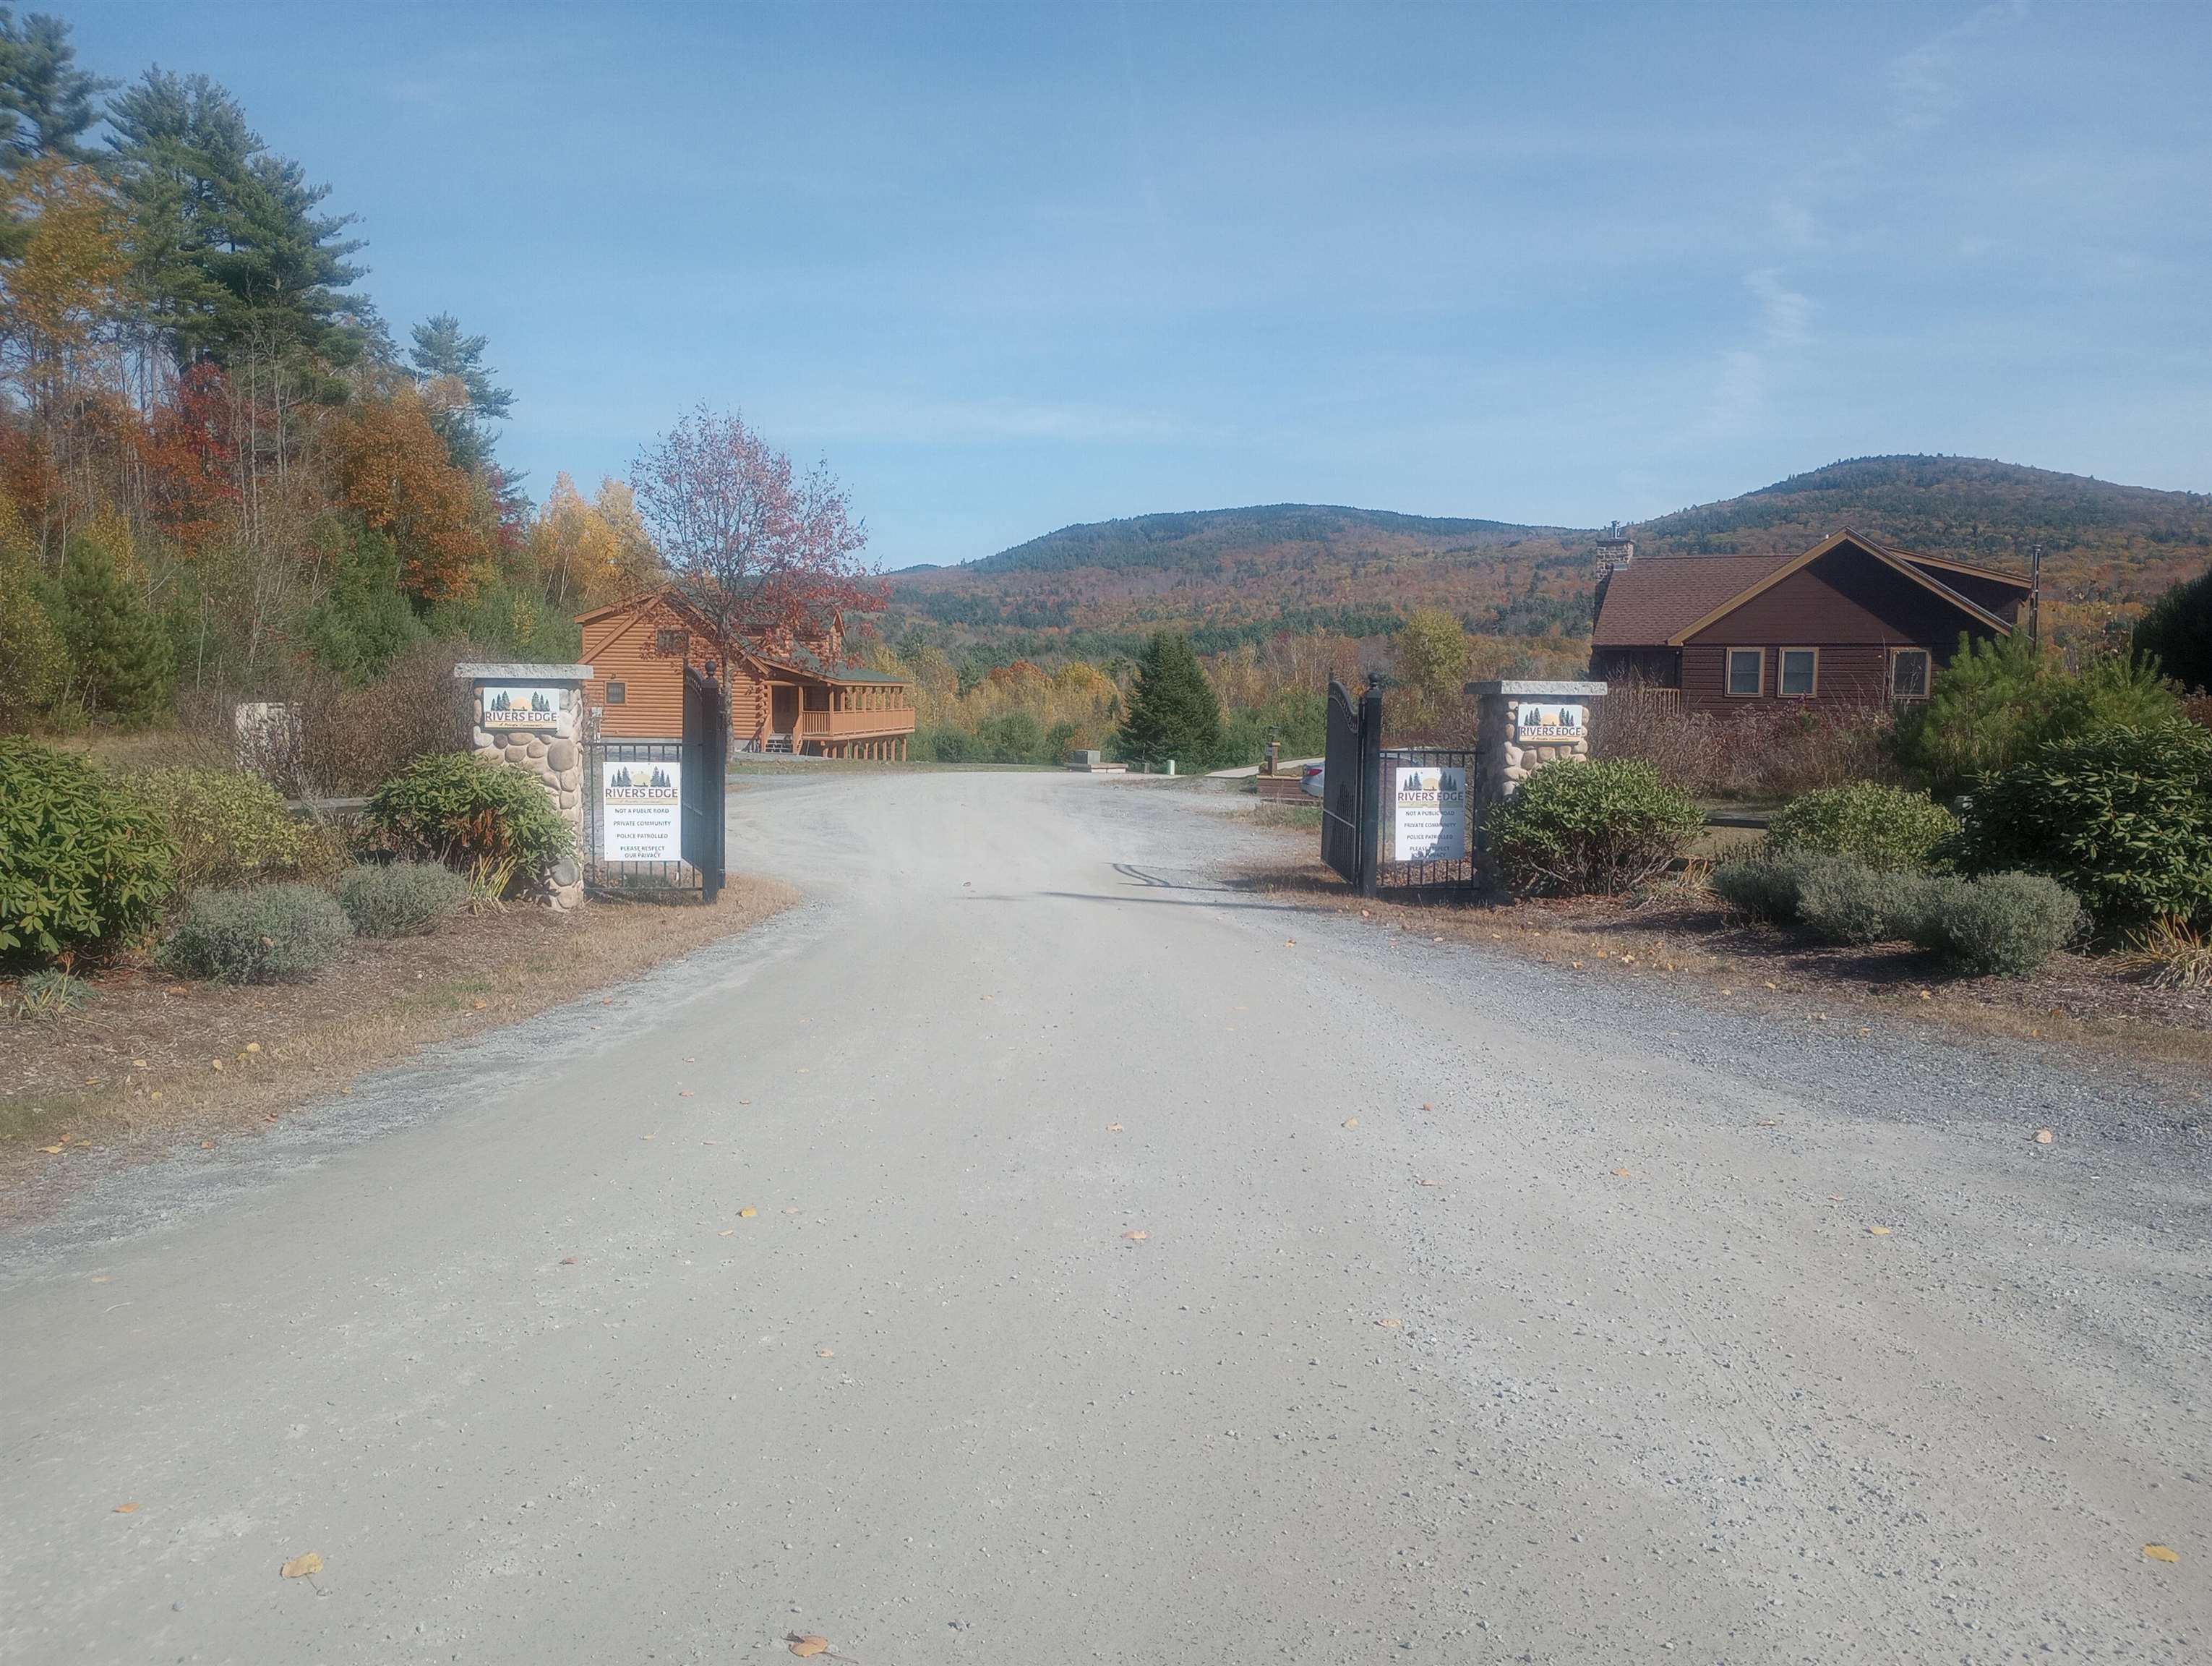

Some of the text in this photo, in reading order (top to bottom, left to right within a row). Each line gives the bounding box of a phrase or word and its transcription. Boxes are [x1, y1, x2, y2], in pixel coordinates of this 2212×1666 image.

[486, 712, 557, 722] RIVERS EDGE
[1520, 727, 1554, 735] RIVERS
[605, 788, 678, 798] RIVERS EDGE
[1397, 792, 1464, 800] RIVERS EDGE
